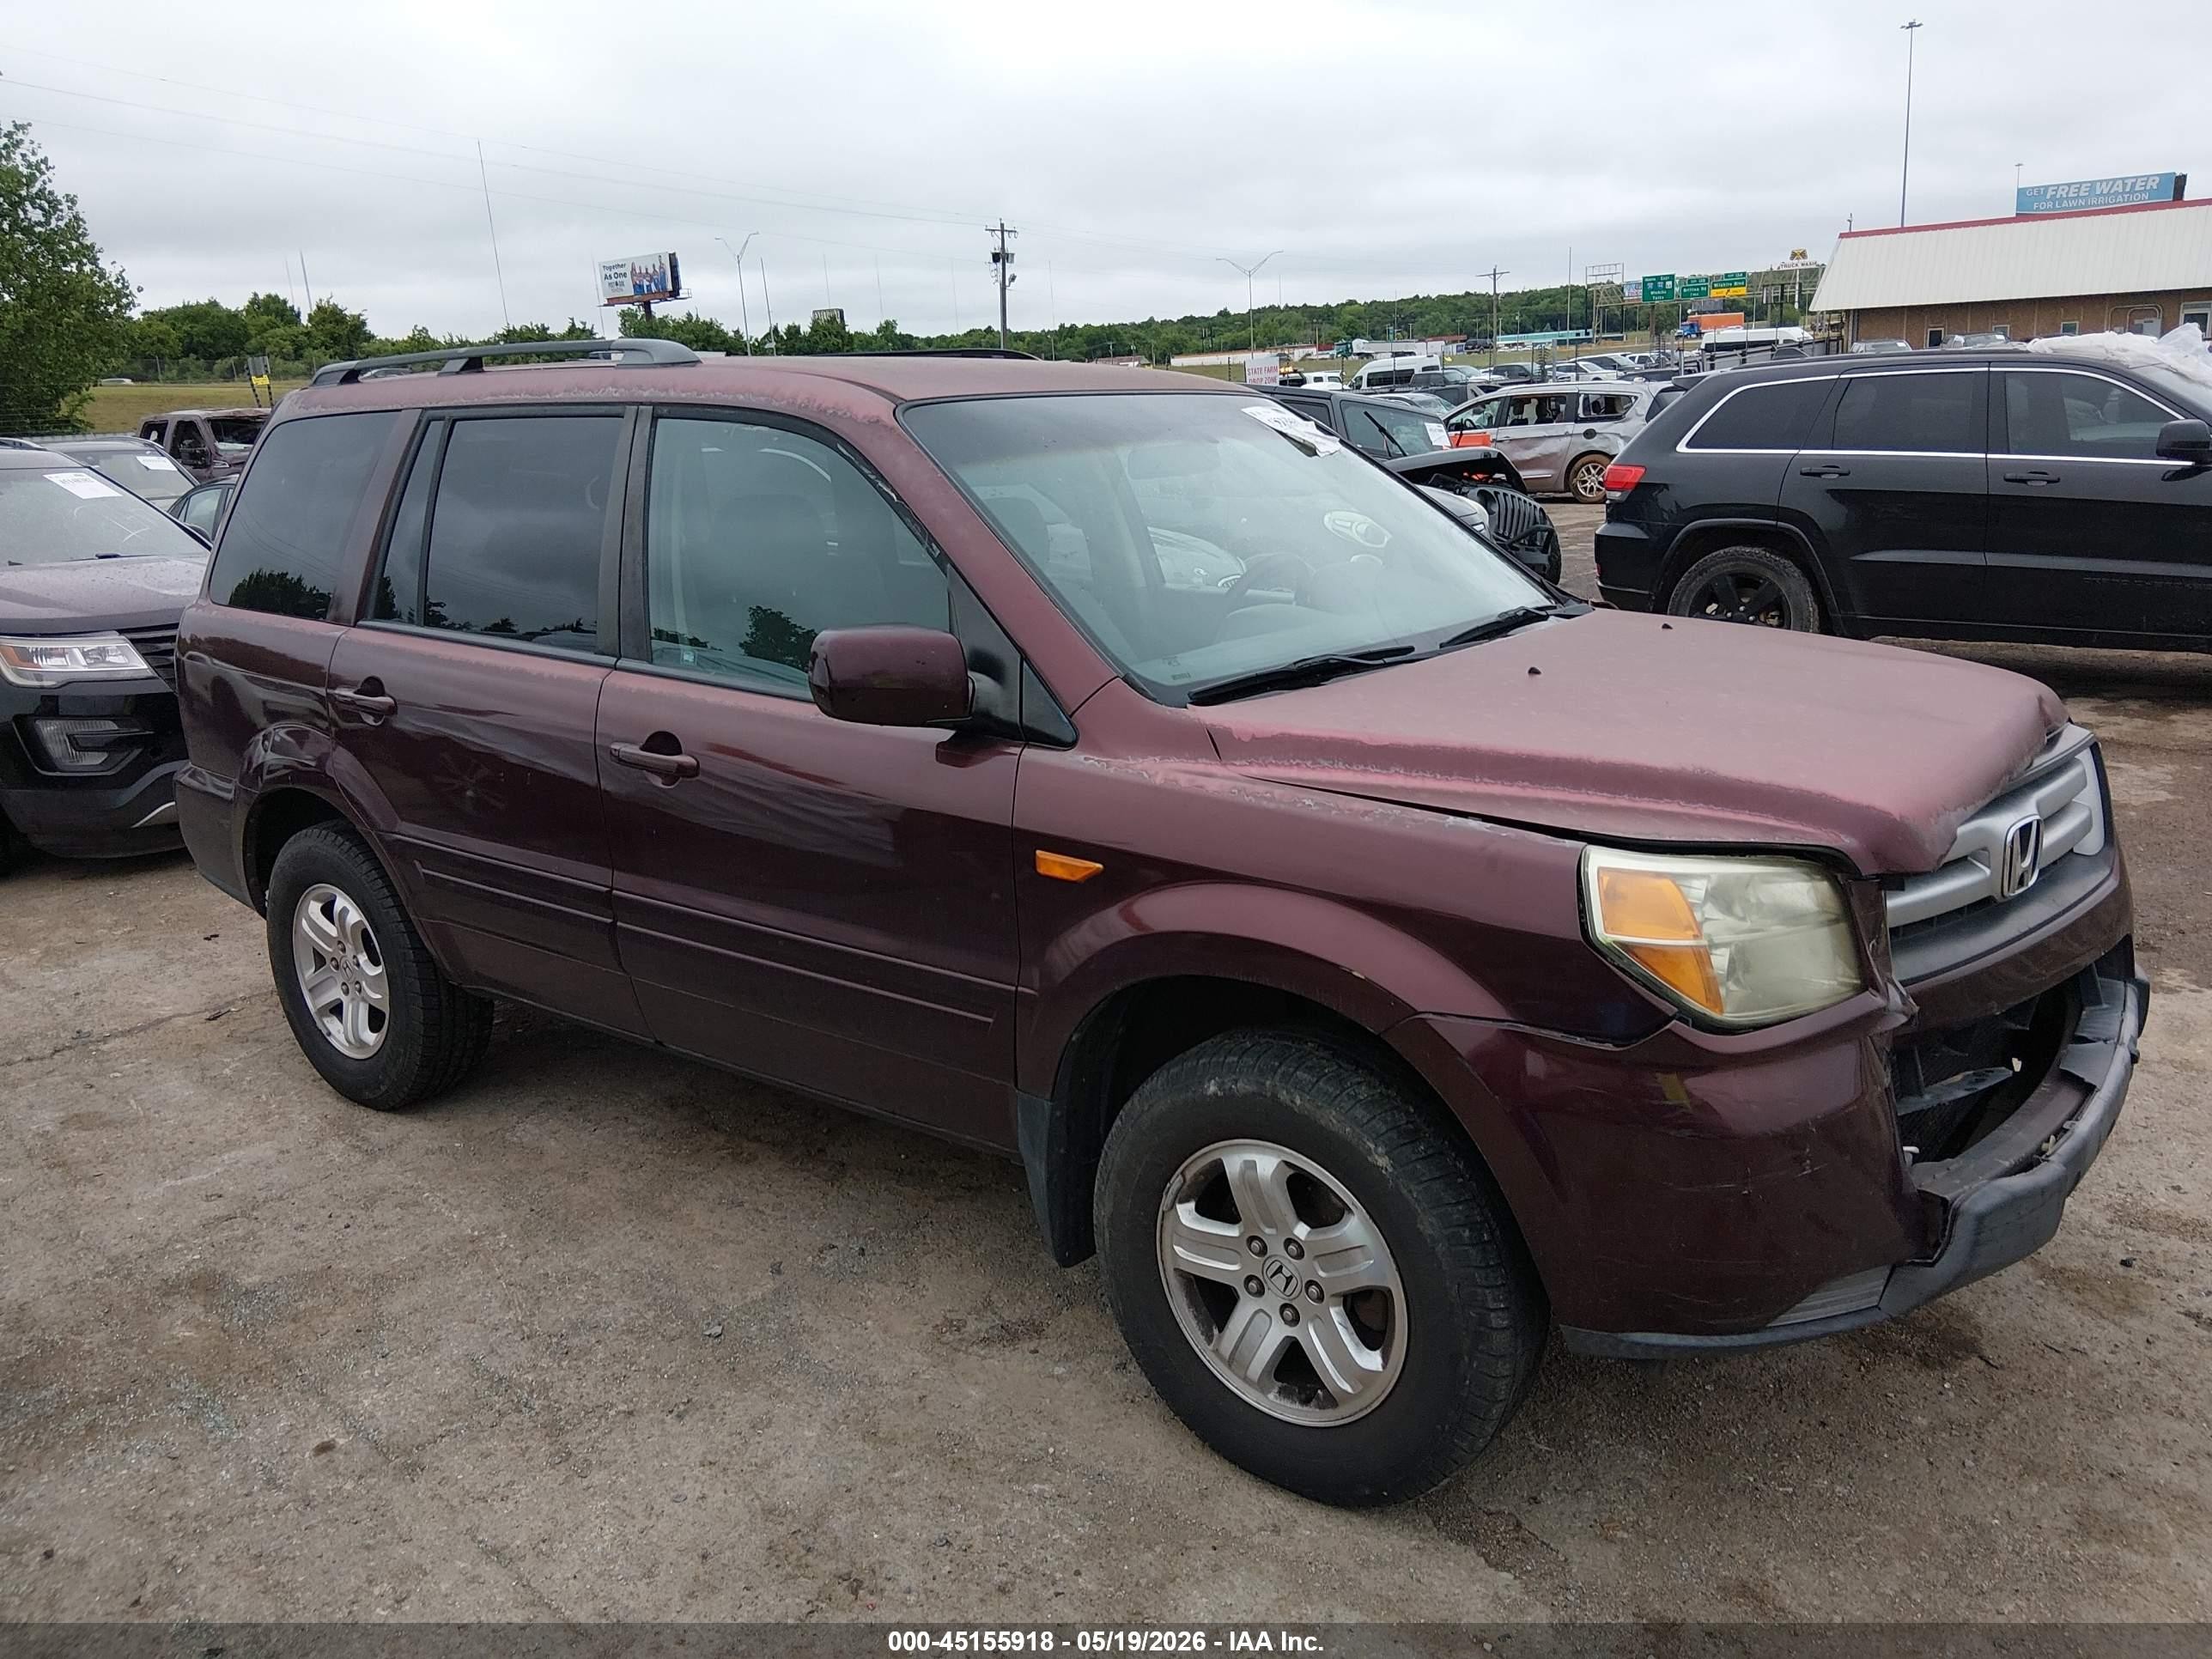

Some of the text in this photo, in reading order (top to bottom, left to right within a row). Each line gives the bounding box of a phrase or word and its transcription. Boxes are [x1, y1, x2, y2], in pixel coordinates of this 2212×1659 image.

[2026, 176, 2160, 199] GET FREE WATER
[2033, 191, 2149, 210] FOR LAWN IRRIGATION
[602, 263, 627, 272] Together
[1247, 365, 1279, 376] STATE FARM
[1264, 376, 1277, 385] ZONE
